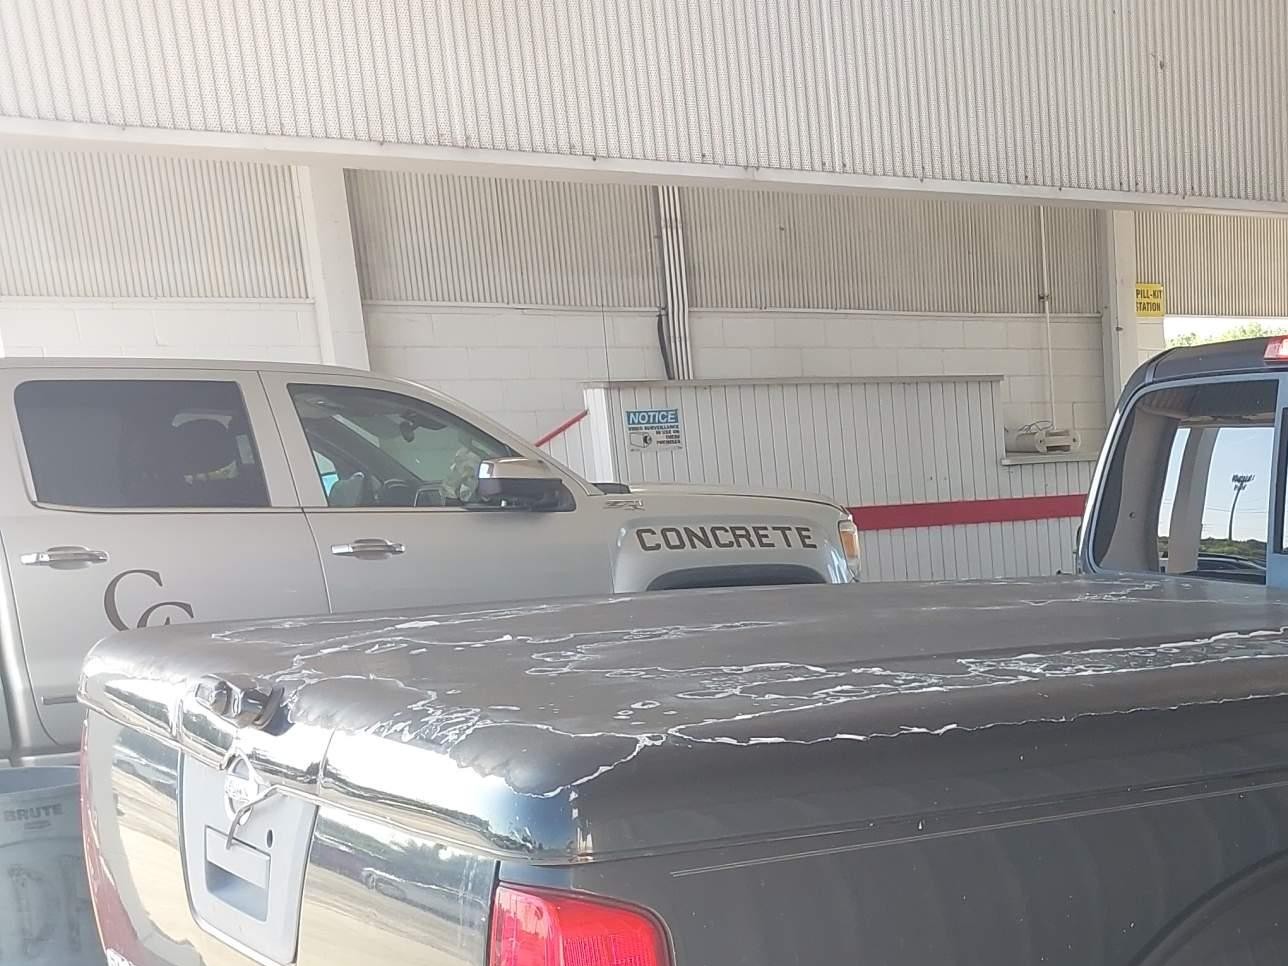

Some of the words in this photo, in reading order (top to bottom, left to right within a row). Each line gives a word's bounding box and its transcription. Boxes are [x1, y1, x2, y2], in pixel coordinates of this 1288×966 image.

[1136, 289, 1162, 300] PILL-KIT
[629, 411, 676, 424] NOTICE
[635, 526, 818, 552] CONCRETE
[4, 804, 64, 822] BRUTE
